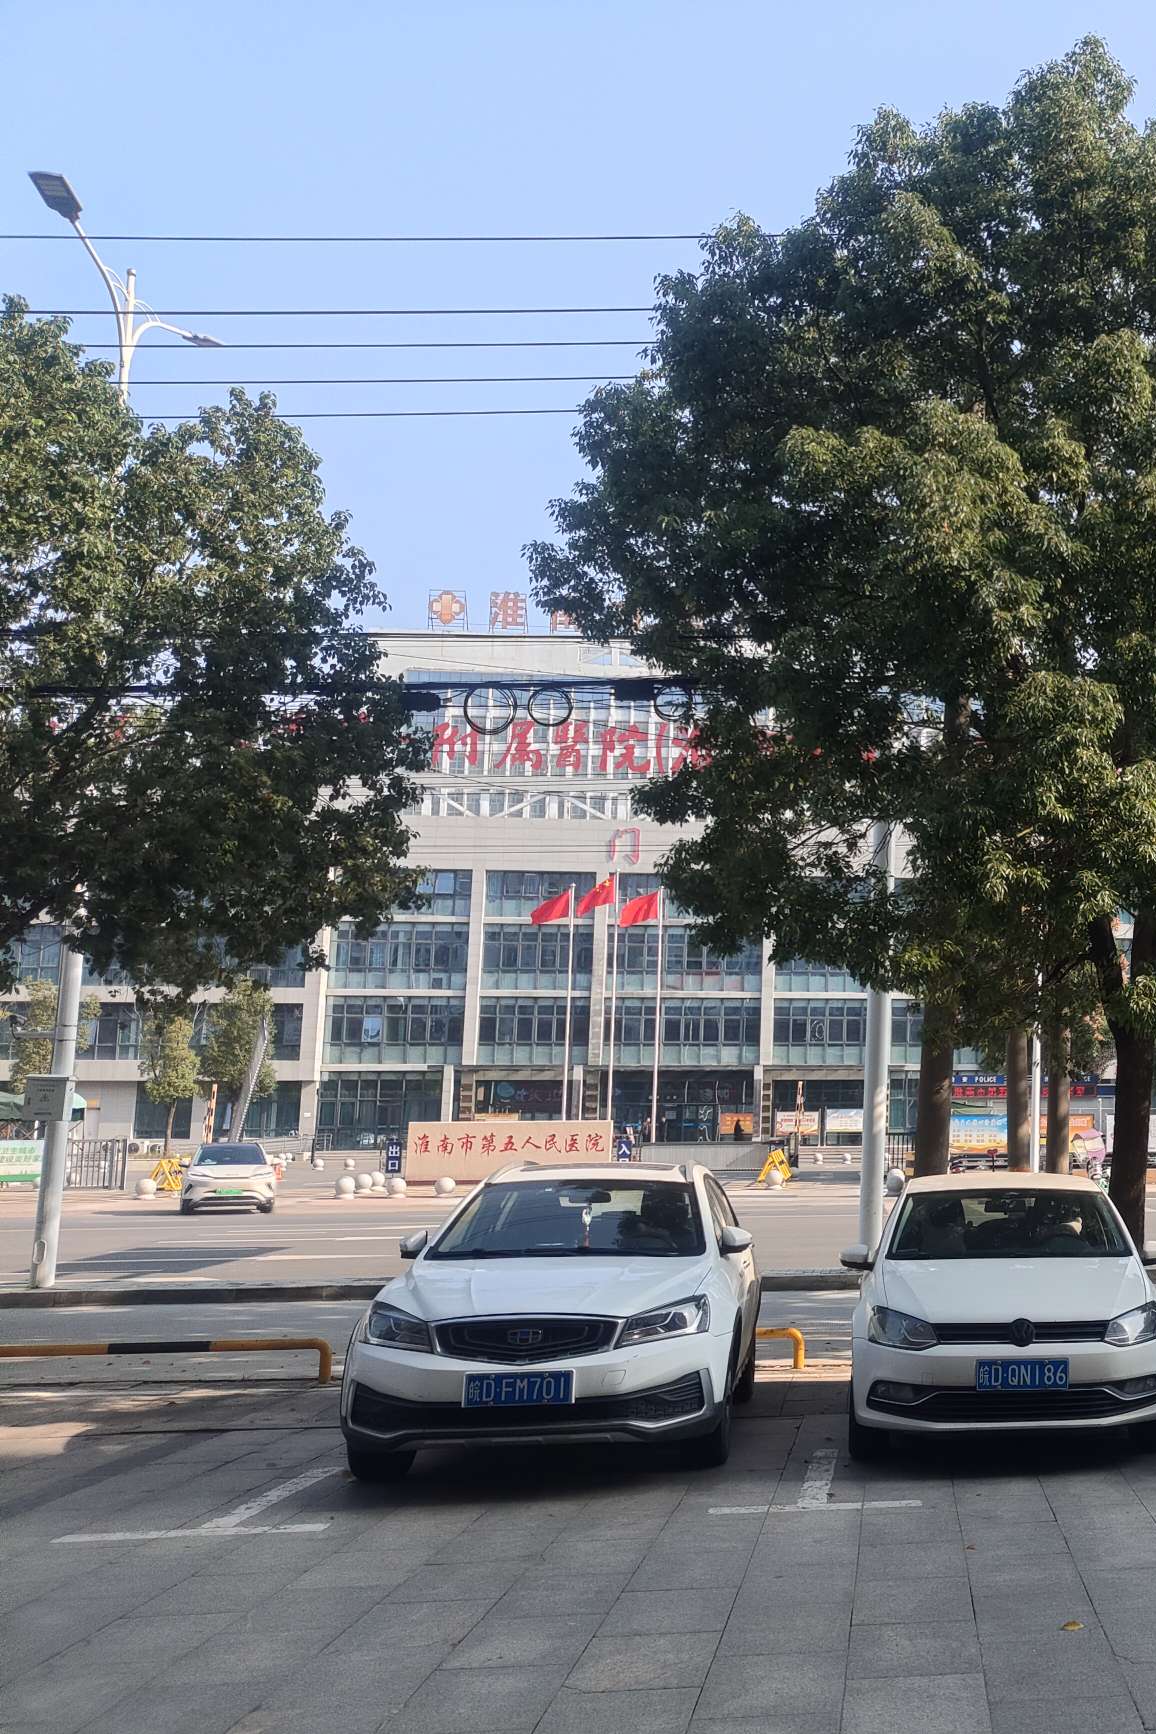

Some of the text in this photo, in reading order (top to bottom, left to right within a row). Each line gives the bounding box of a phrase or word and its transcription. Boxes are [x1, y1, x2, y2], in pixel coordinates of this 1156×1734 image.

[974, 1075, 997, 1084] POLICE
[388, 1144, 400, 1171] 出口
[414, 1133, 605, 1160] 淮南市第五人民医院
